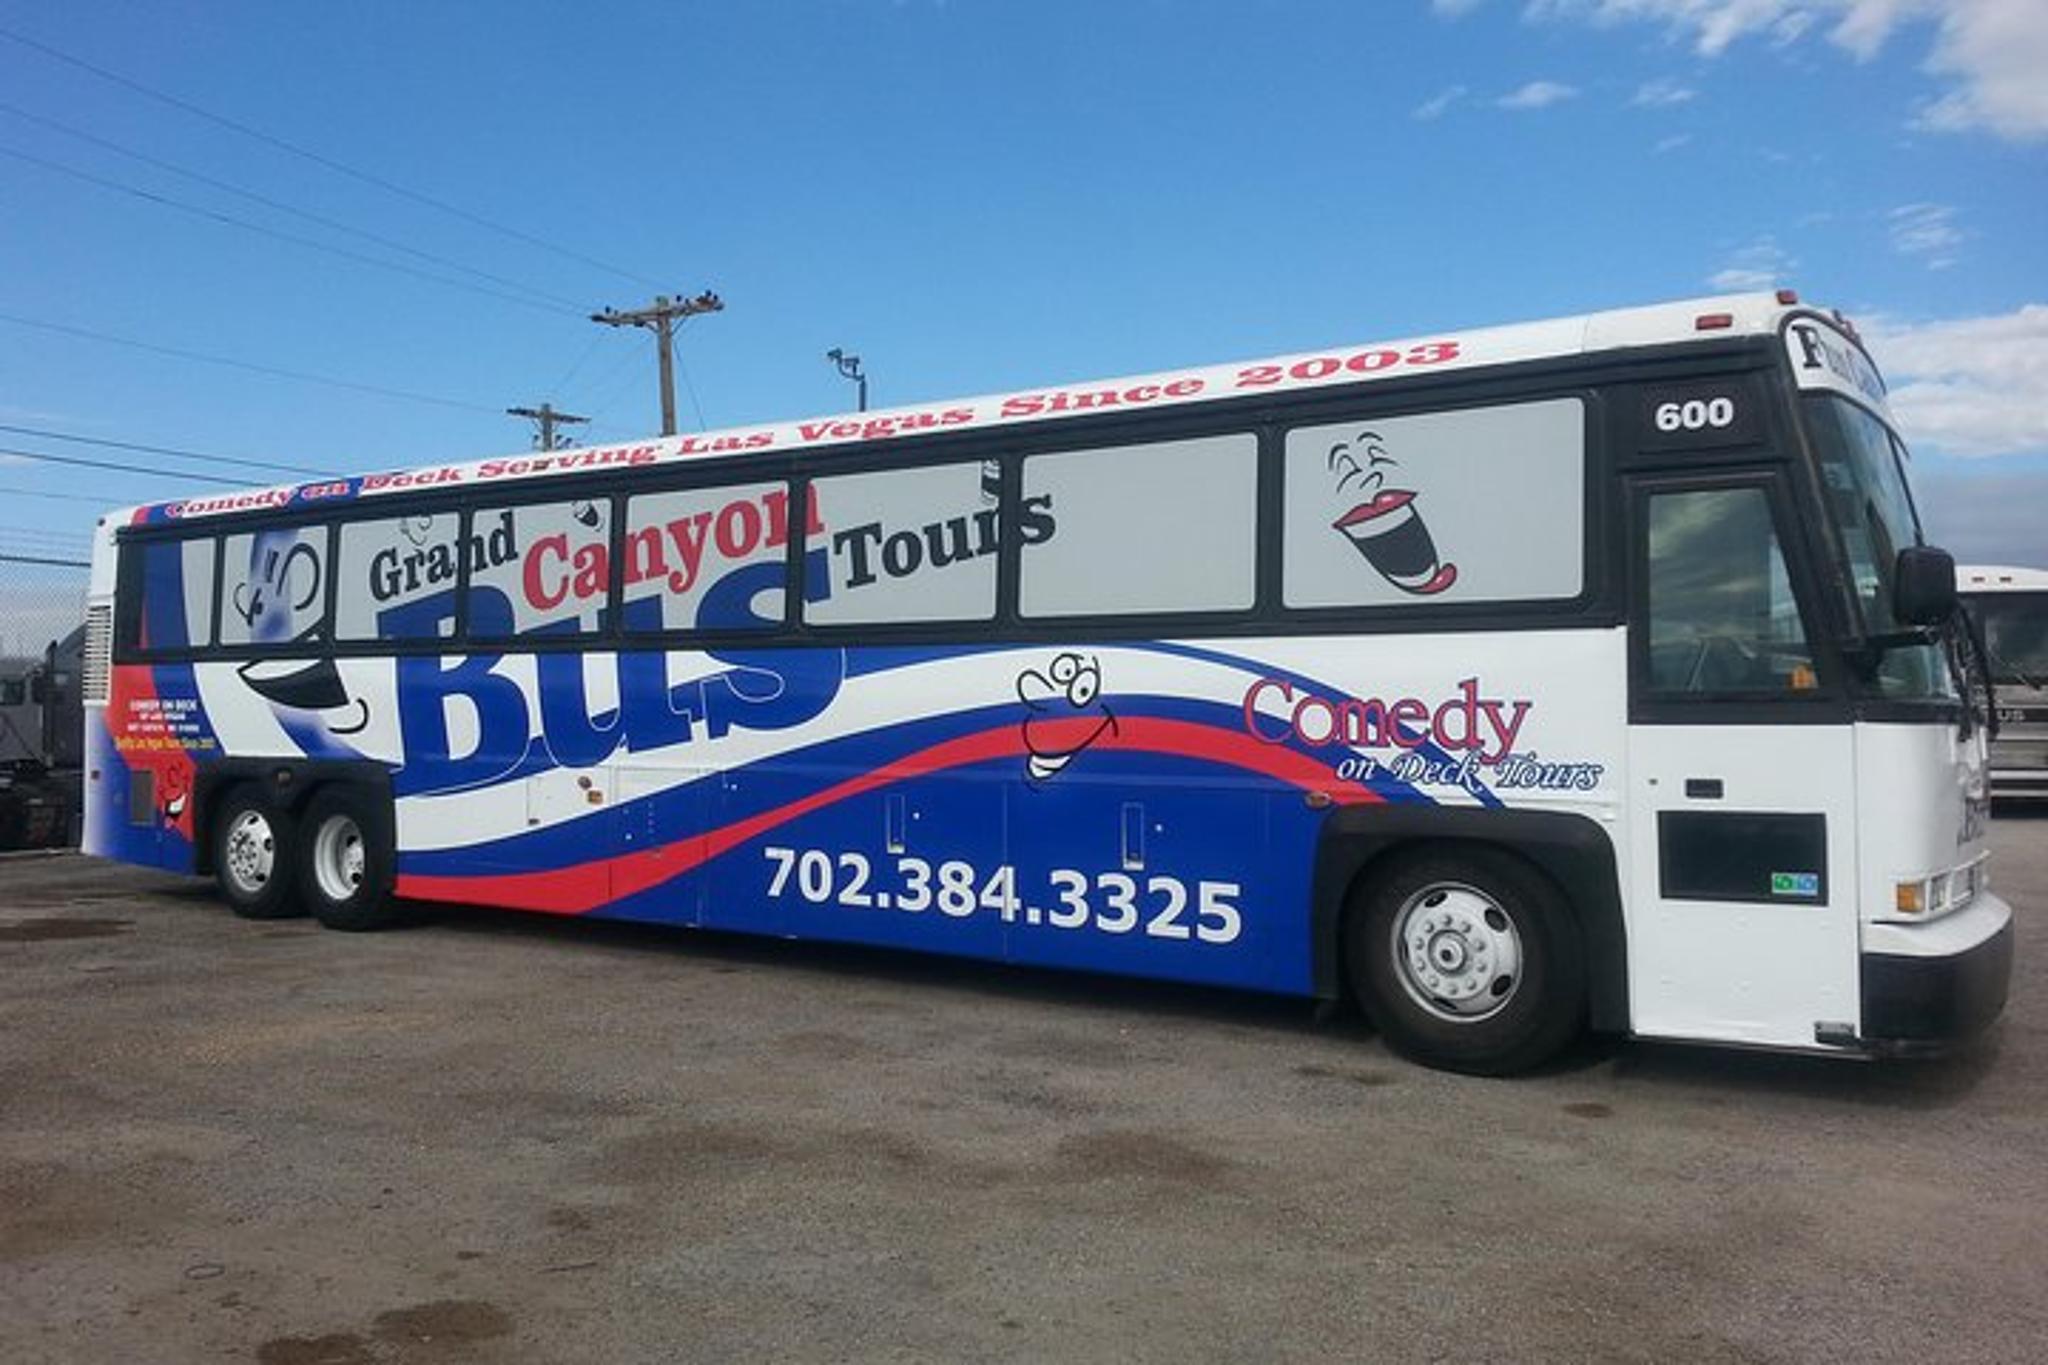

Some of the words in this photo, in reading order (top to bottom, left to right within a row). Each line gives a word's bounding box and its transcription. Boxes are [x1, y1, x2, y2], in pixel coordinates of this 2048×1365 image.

[164, 488, 294, 518] Comedy
[301, 482, 350, 500] on
[362, 467, 463, 491] Deck
[476, 444, 663, 479] Serving
[676, 431, 774, 455] Las
[796, 407, 975, 441] Vegas
[1000, 379, 1205, 418] Since
[1236, 341, 1460, 388] 2003
[1656, 397, 1733, 431] 600
[370, 511, 518, 601] Grand
[522, 481, 825, 611] Canyon
[833, 494, 1056, 589] Tours
[377, 549, 847, 797] Bus
[1243, 676, 1532, 764] Comedy
[1336, 757, 1378, 781] on
[1391, 750, 1485, 793] Deck
[1495, 750, 1604, 790] Tours
[764, 847, 1242, 943] 702.384.3325
